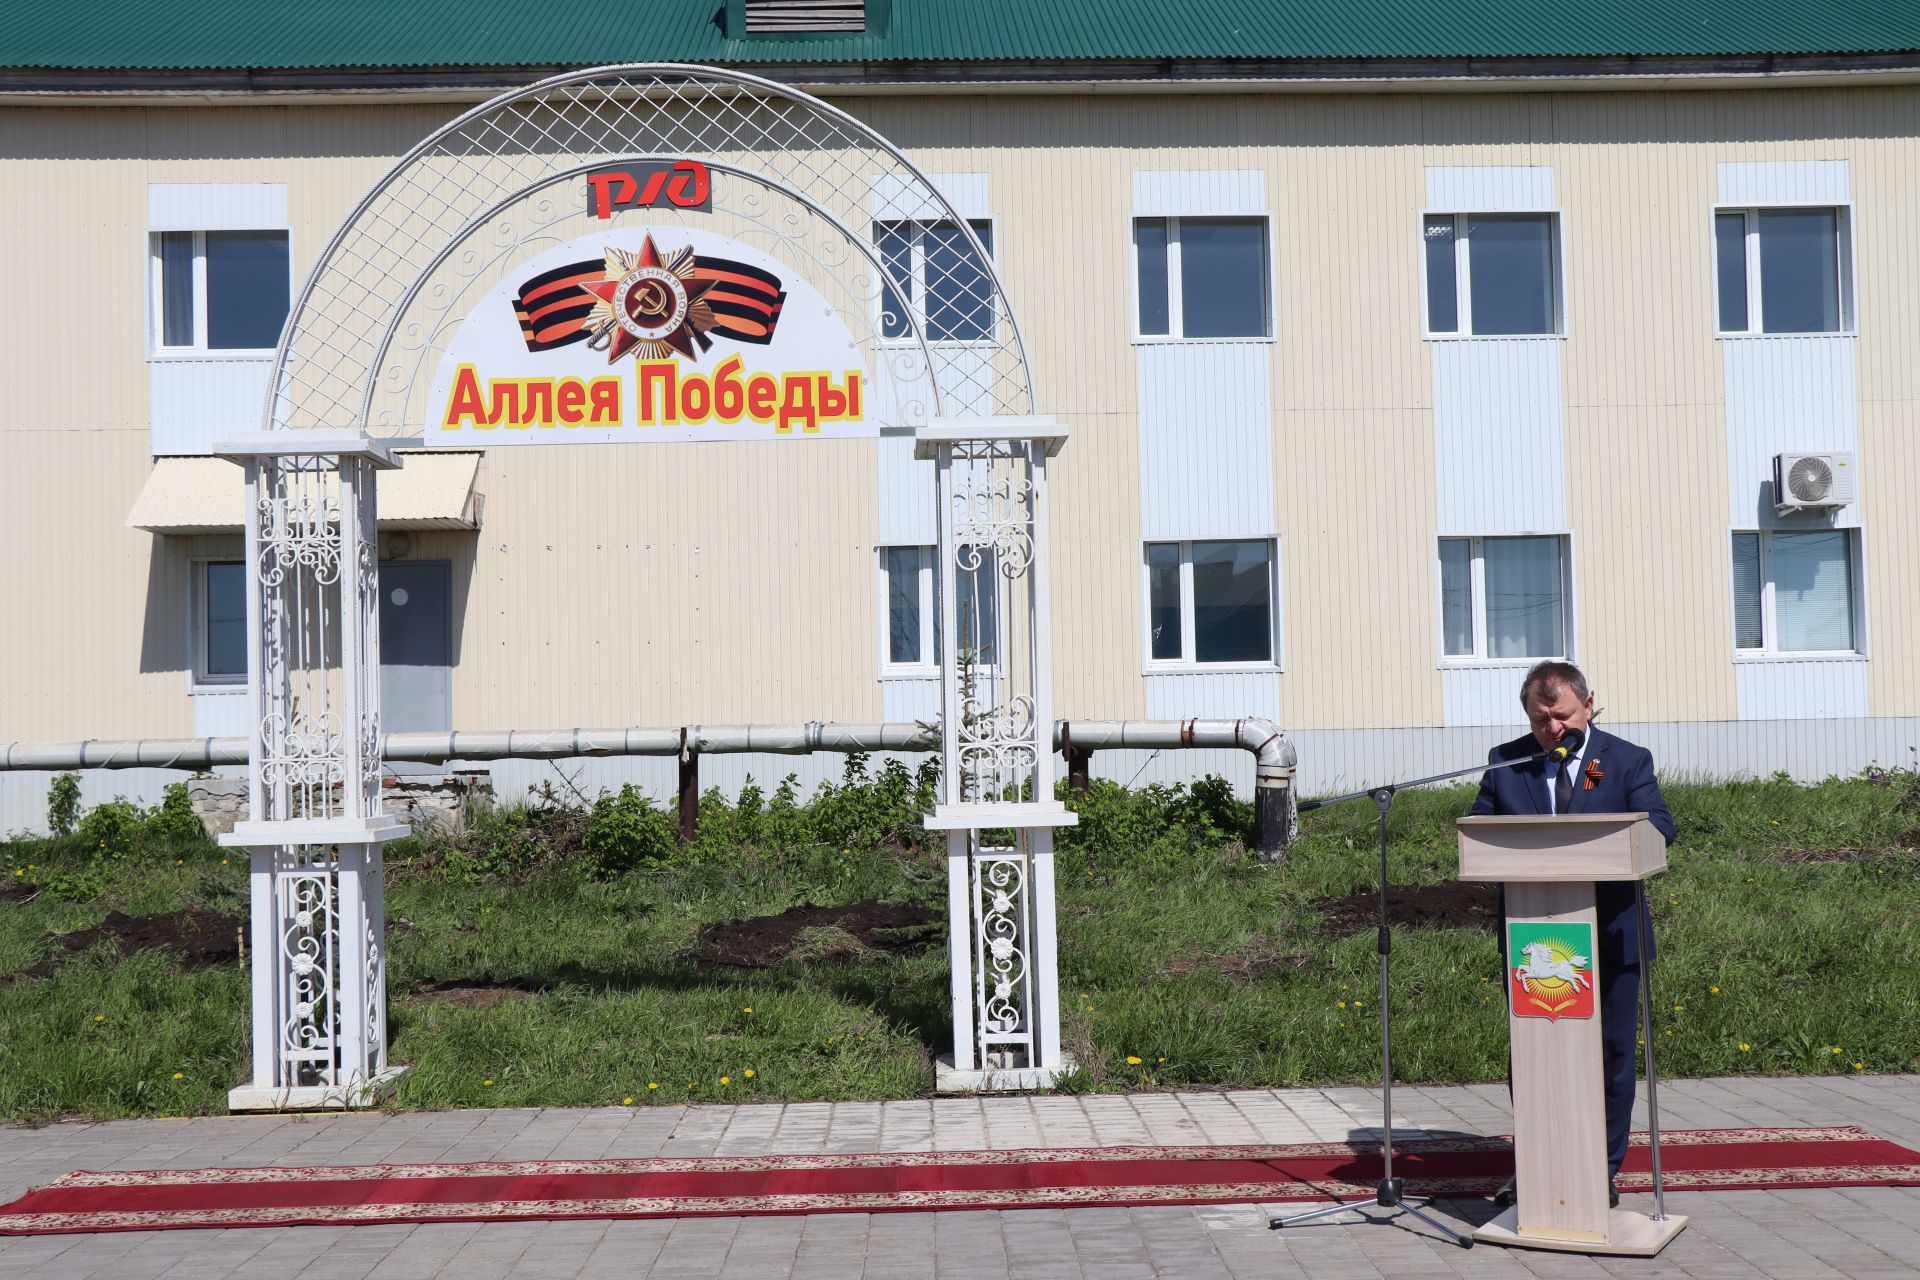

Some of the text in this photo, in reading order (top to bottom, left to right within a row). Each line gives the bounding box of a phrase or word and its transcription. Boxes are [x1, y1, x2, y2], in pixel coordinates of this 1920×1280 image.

[616, 269, 686, 333] ОТЕЧЕСТВЕННАЯ ВОЙНА
[445, 356, 861, 430] Аллея Победы
